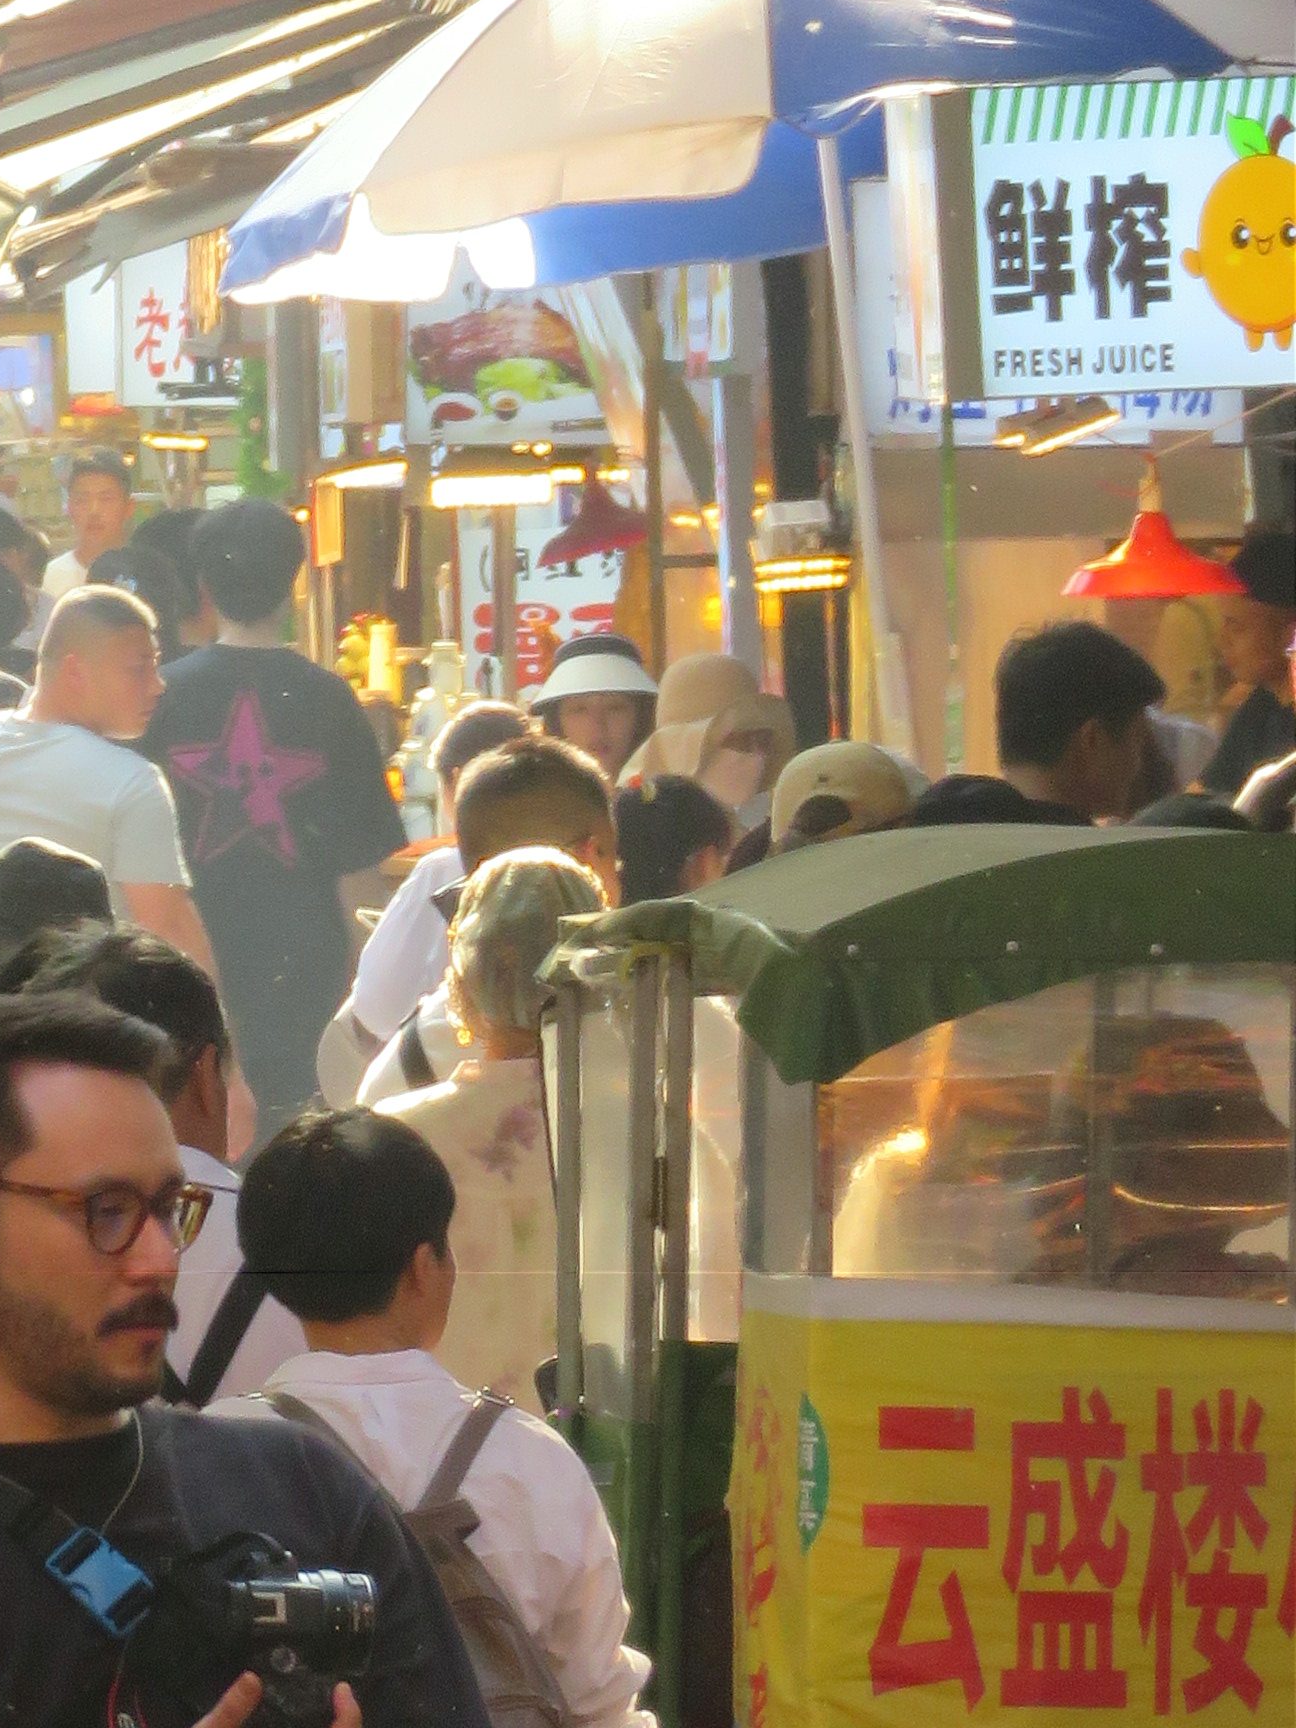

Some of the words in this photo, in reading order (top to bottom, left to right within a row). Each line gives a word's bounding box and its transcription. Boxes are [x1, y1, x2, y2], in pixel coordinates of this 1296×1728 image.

[985, 174, 1173, 322] 鲜榨
[993, 347, 1083, 377] FRESH
[1092, 343, 1175, 374] JUICE
[862, 1386, 1296, 1716] 云盛楼
